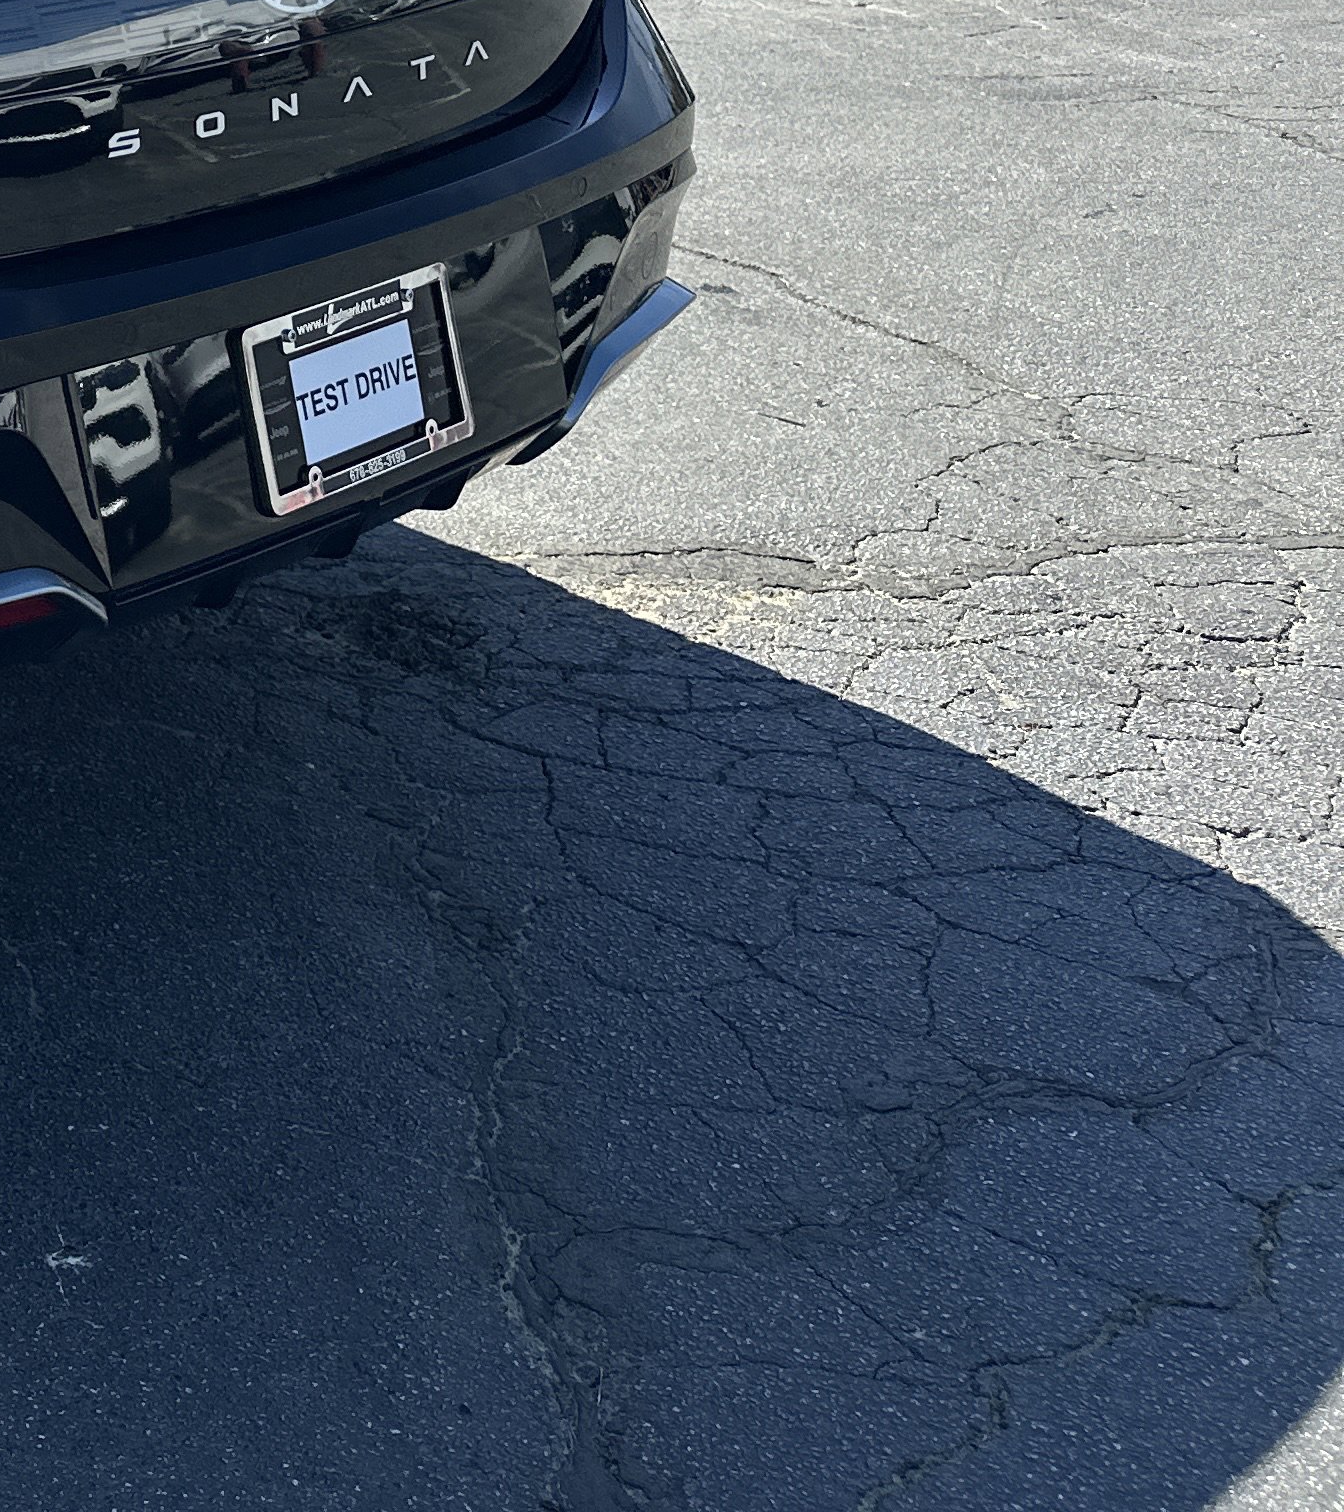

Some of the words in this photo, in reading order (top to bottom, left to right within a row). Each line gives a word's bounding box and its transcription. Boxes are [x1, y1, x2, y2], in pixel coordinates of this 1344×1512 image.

[108, 40, 489, 158] SONATA
[296, 378, 349, 421] TEST
[354, 353, 417, 400] DRIVE
